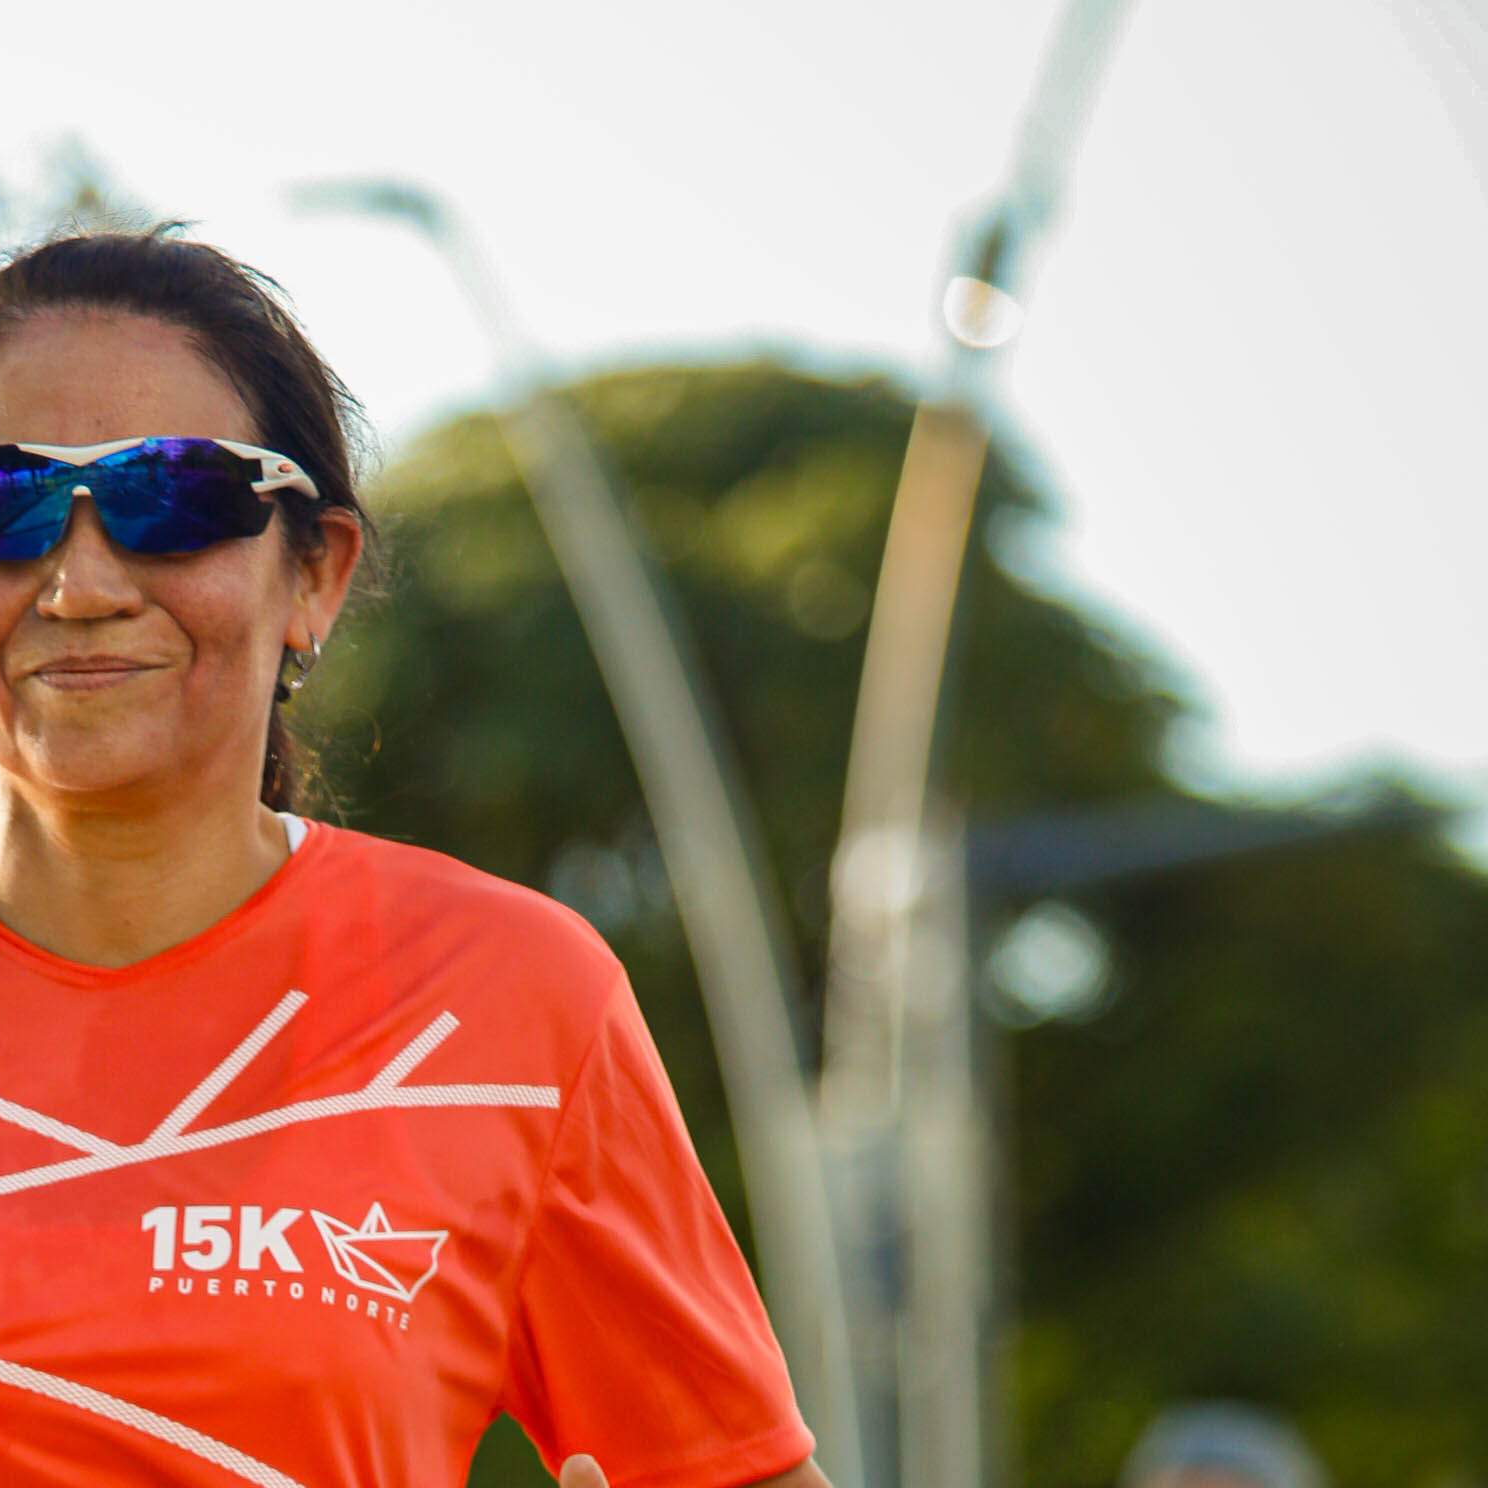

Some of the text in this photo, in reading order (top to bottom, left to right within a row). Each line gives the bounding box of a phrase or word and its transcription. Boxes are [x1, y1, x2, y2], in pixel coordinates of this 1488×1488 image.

[141, 1205, 304, 1273] 15K
[149, 1277, 410, 1331] PUERTO NORTE
